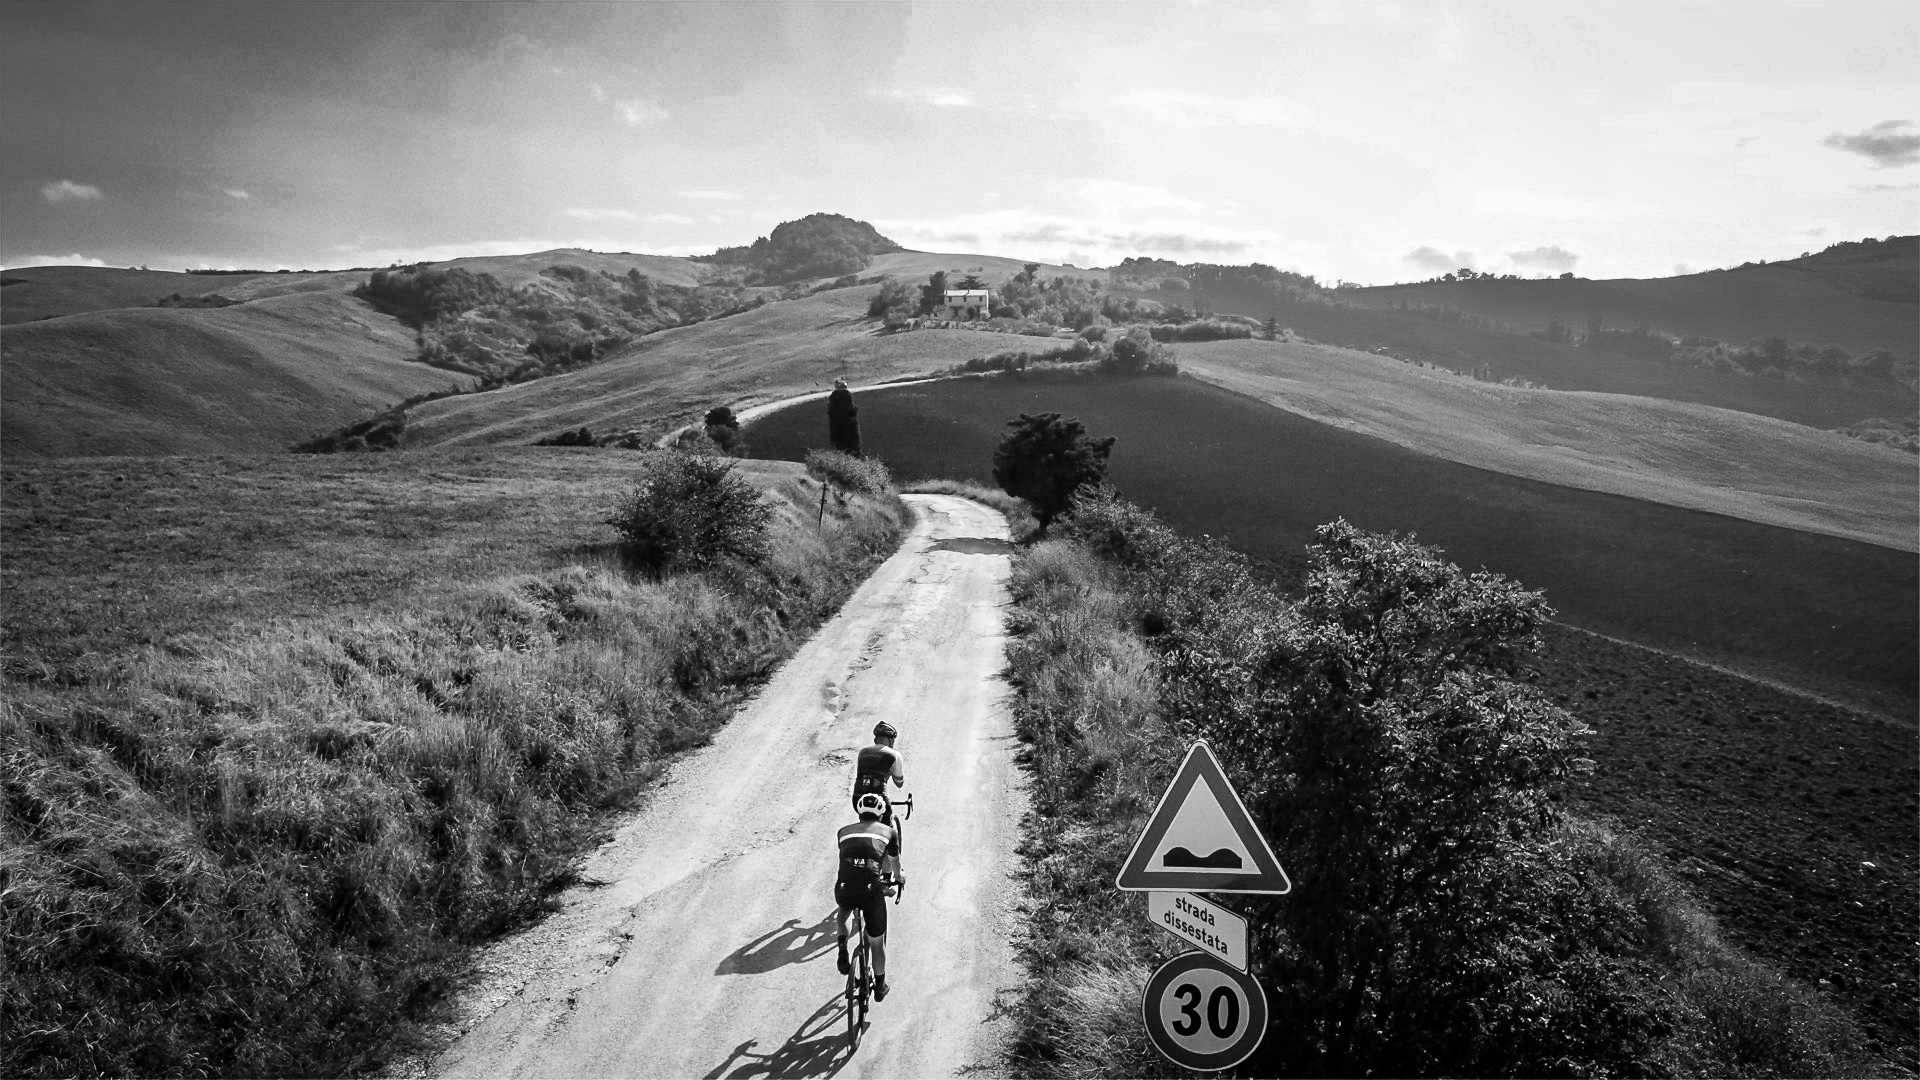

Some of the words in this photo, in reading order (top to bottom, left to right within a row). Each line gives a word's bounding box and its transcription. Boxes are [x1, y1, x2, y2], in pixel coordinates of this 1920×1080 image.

[1164, 910, 1228, 955] dissestata
[1175, 897, 1215, 926] strada
[1171, 983, 1240, 1039] 30
